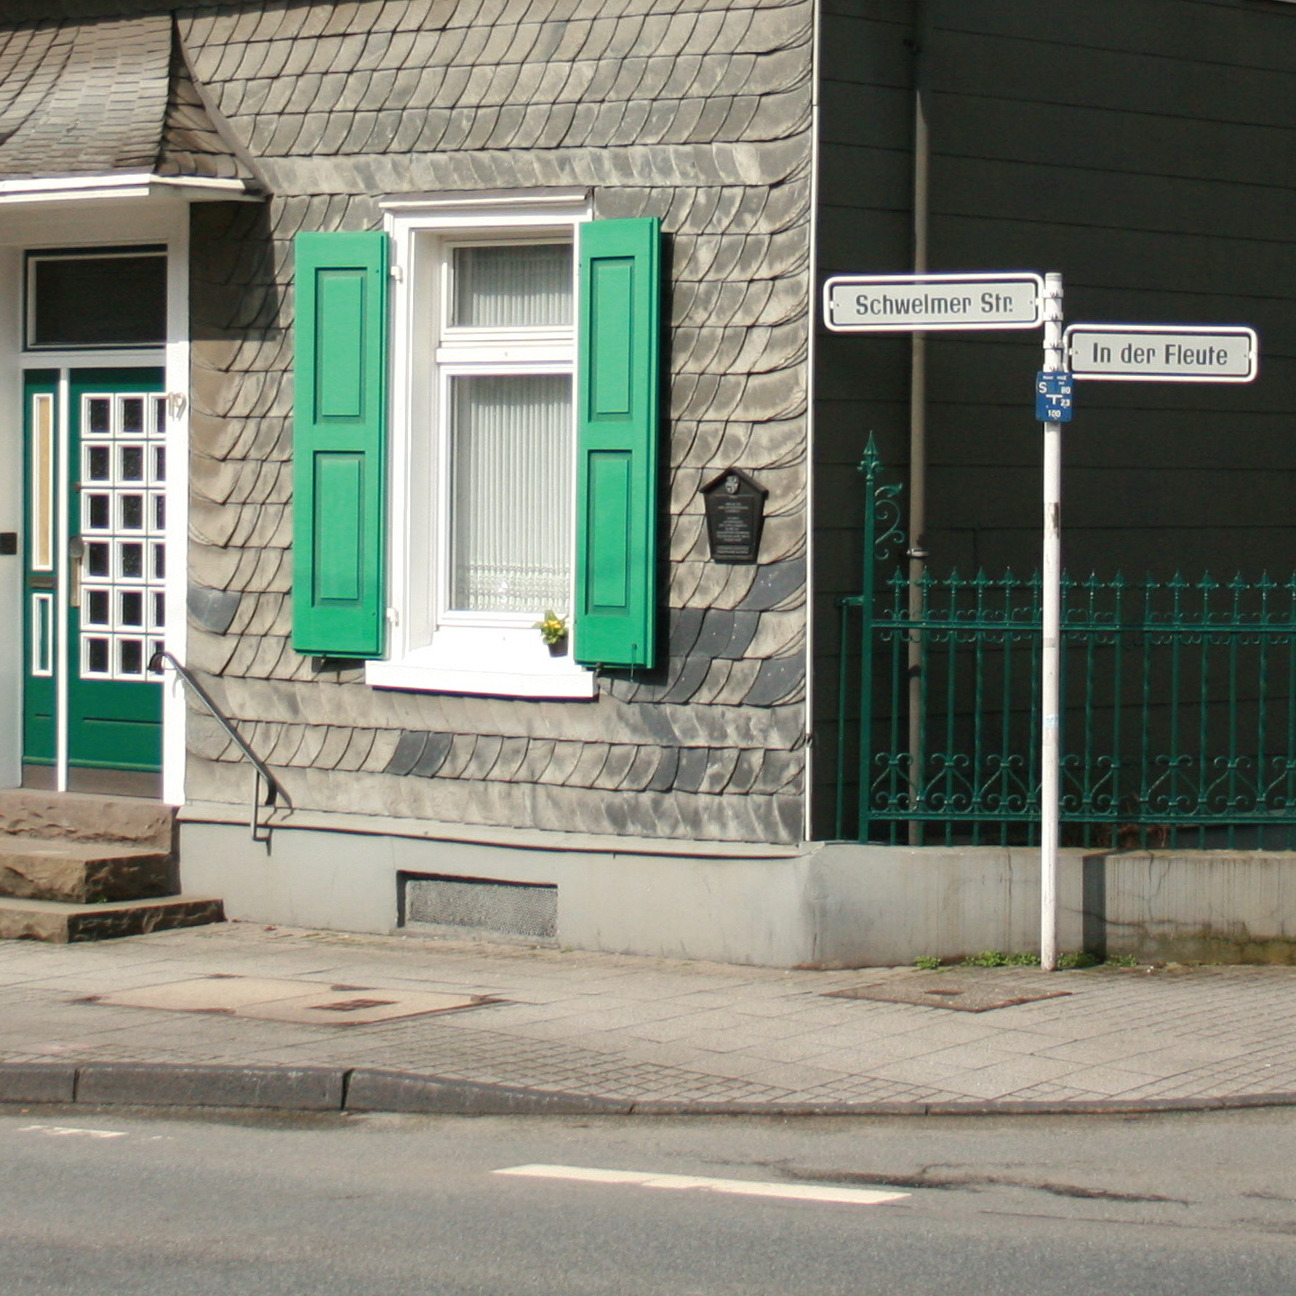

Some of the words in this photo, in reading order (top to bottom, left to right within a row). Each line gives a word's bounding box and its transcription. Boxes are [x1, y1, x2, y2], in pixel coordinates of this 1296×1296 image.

[855, 293, 972, 315] Schwelmer
[981, 292, 1013, 313] Str.
[1093, 342, 1111, 363] In
[1120, 343, 1156, 364] der
[1165, 344, 1228, 365] Fleute
[1039, 382, 1047, 393] S
